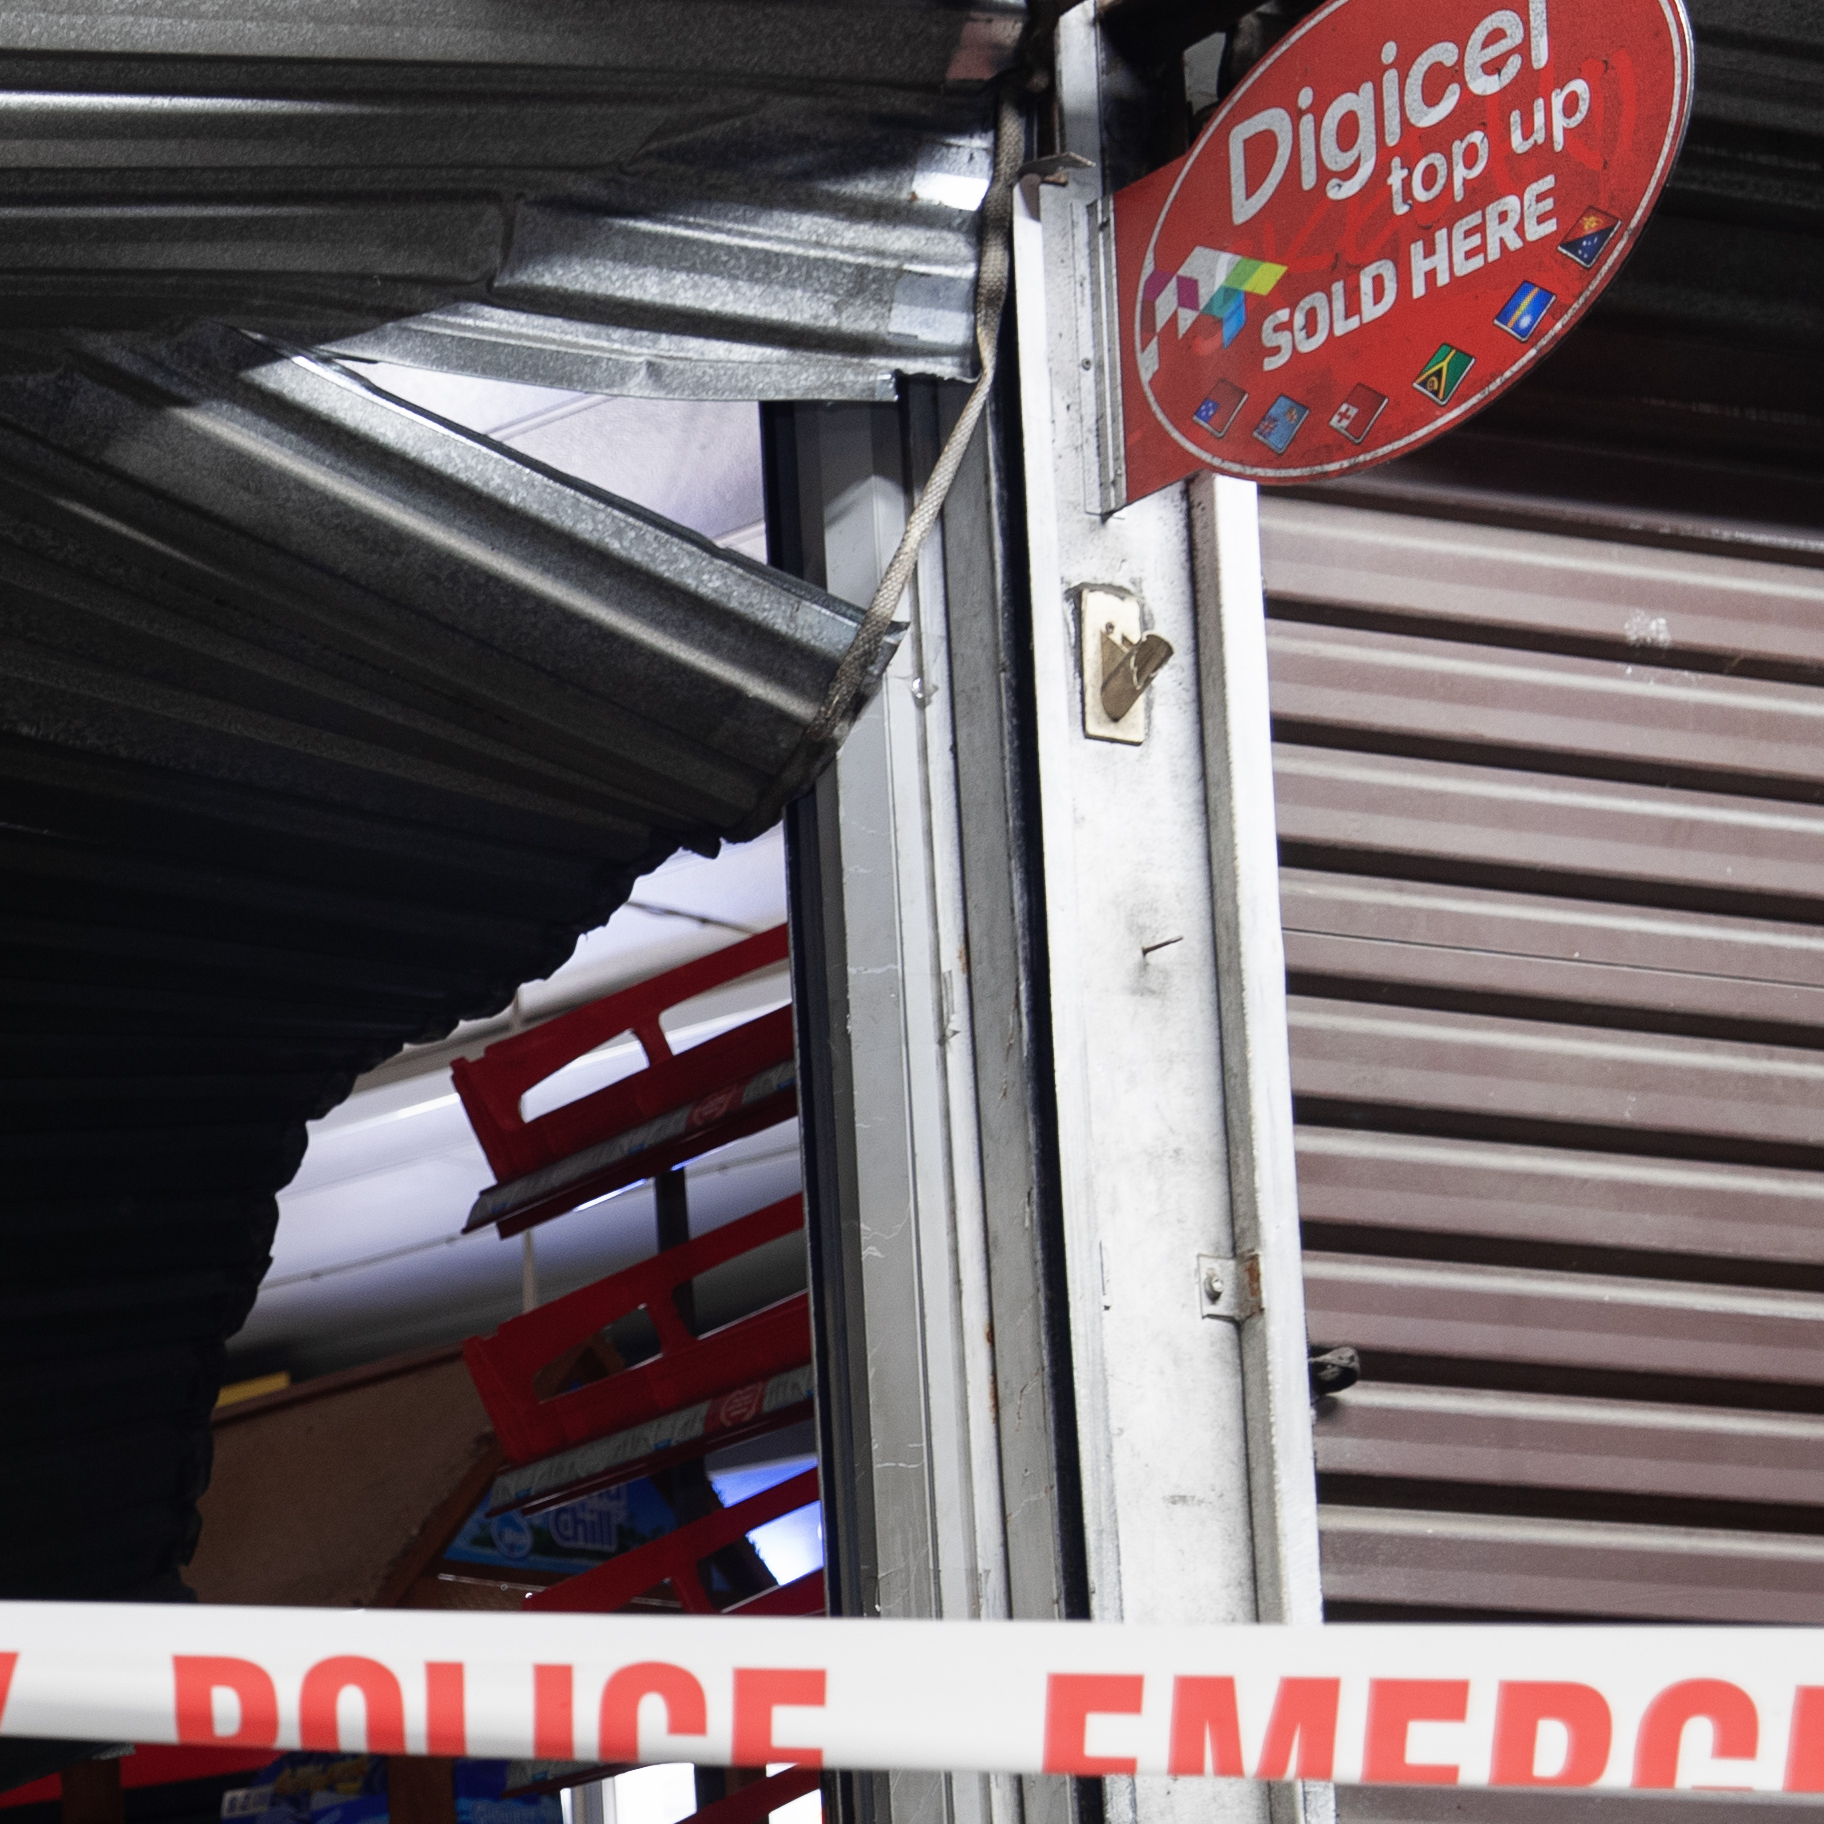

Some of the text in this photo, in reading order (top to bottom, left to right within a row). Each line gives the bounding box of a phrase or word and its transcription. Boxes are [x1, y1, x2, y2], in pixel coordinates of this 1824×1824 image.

[1228, 0, 1549, 225] Digicel
[1387, 78, 1590, 215] top up
[1261, 174, 1558, 372] SOLD HERE
[1040, 1672, 1824, 1793] EMERG
